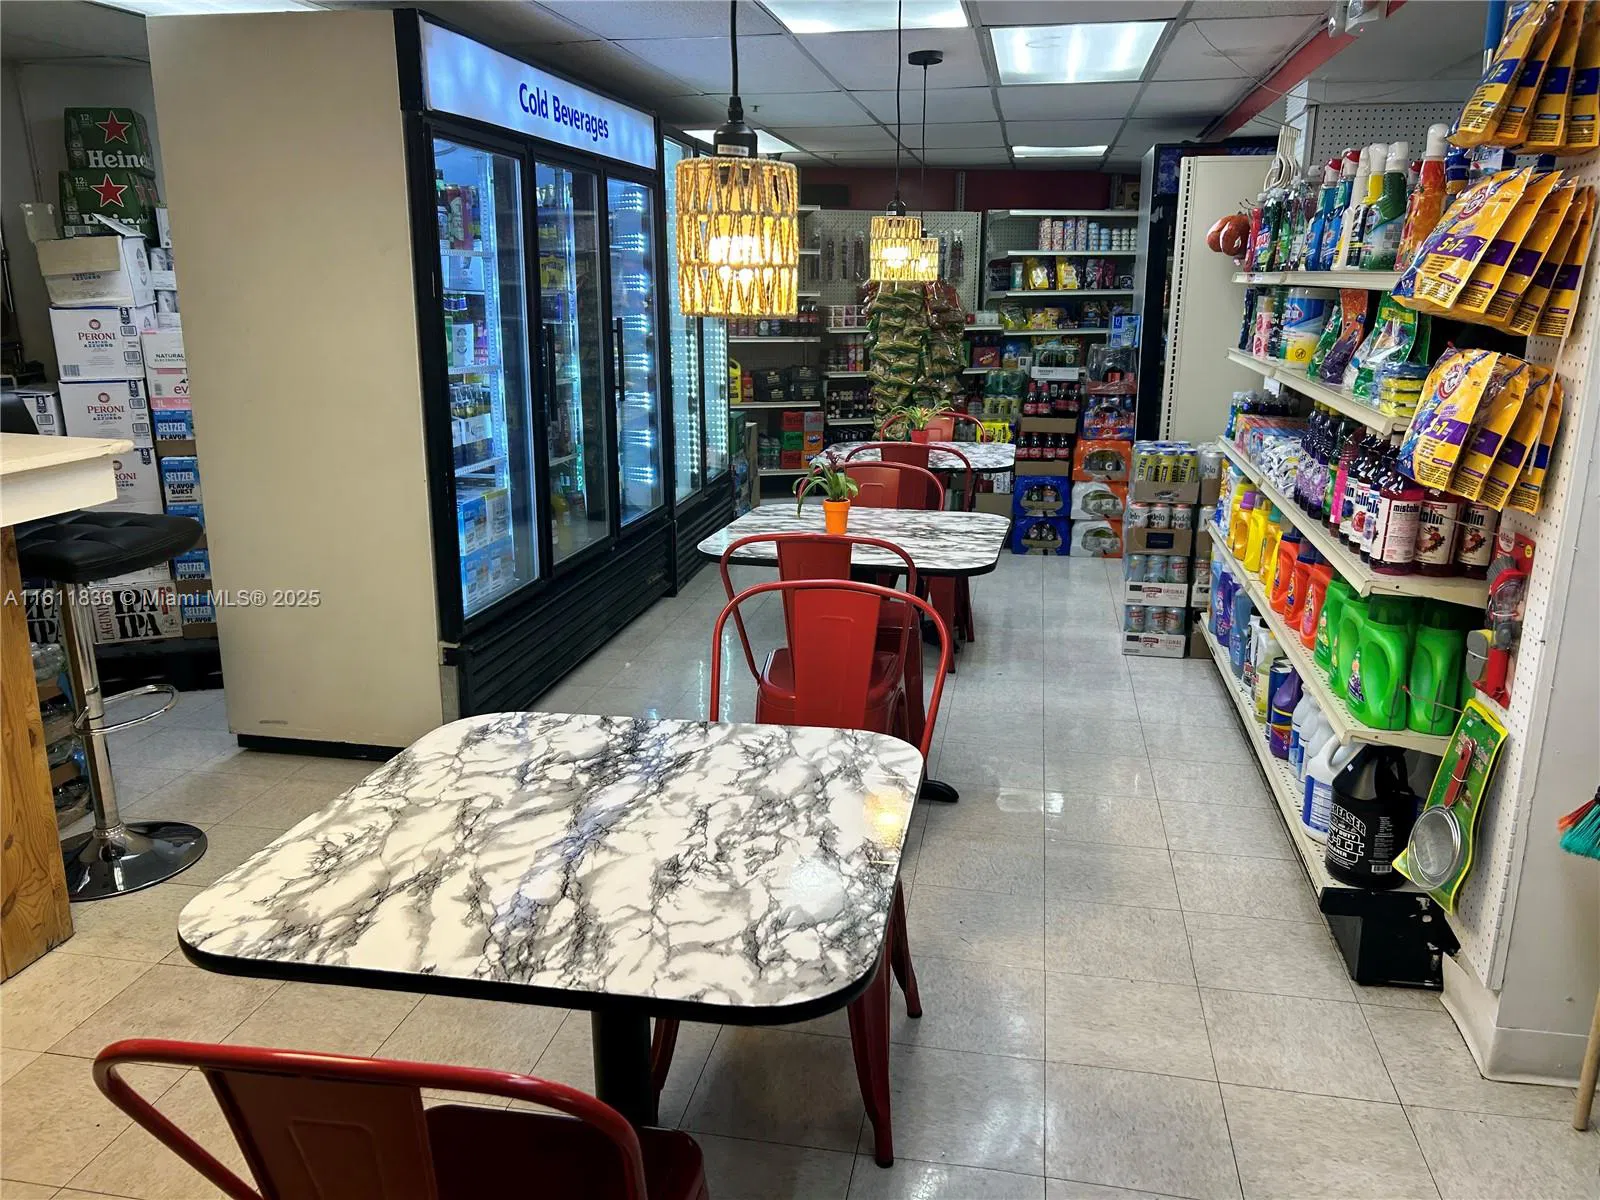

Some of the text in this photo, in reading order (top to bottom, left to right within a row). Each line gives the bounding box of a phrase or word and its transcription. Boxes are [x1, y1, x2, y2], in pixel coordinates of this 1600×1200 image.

[519, 82, 609, 142] Cold Beverages
[78, 332, 116, 341] PERONI
[87, 405, 125, 414] PERONI
[158, 422, 187, 433] SELTZER
[165, 472, 195, 482] SELTZER
[177, 562, 206, 572] SELTZER
[184, 606, 211, 616] SELTZER
[116, 613, 161, 639] IPA
